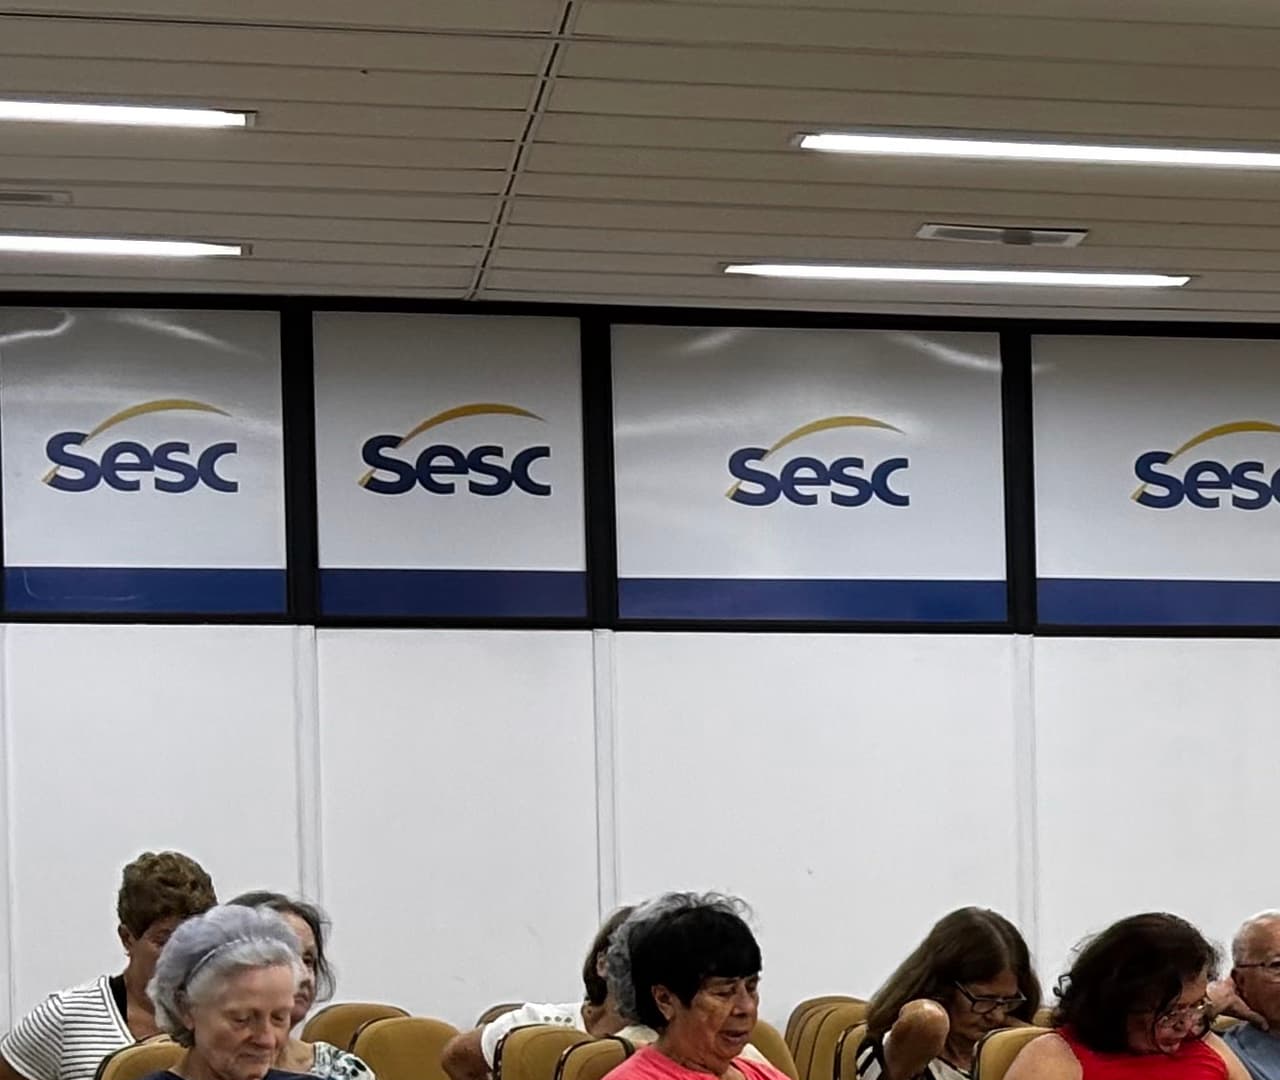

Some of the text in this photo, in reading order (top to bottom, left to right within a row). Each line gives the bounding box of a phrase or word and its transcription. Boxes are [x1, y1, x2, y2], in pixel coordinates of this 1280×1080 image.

[45, 431, 238, 493] Sesc
[362, 434, 551, 496] Sesc
[729, 447, 909, 507] Sesc
